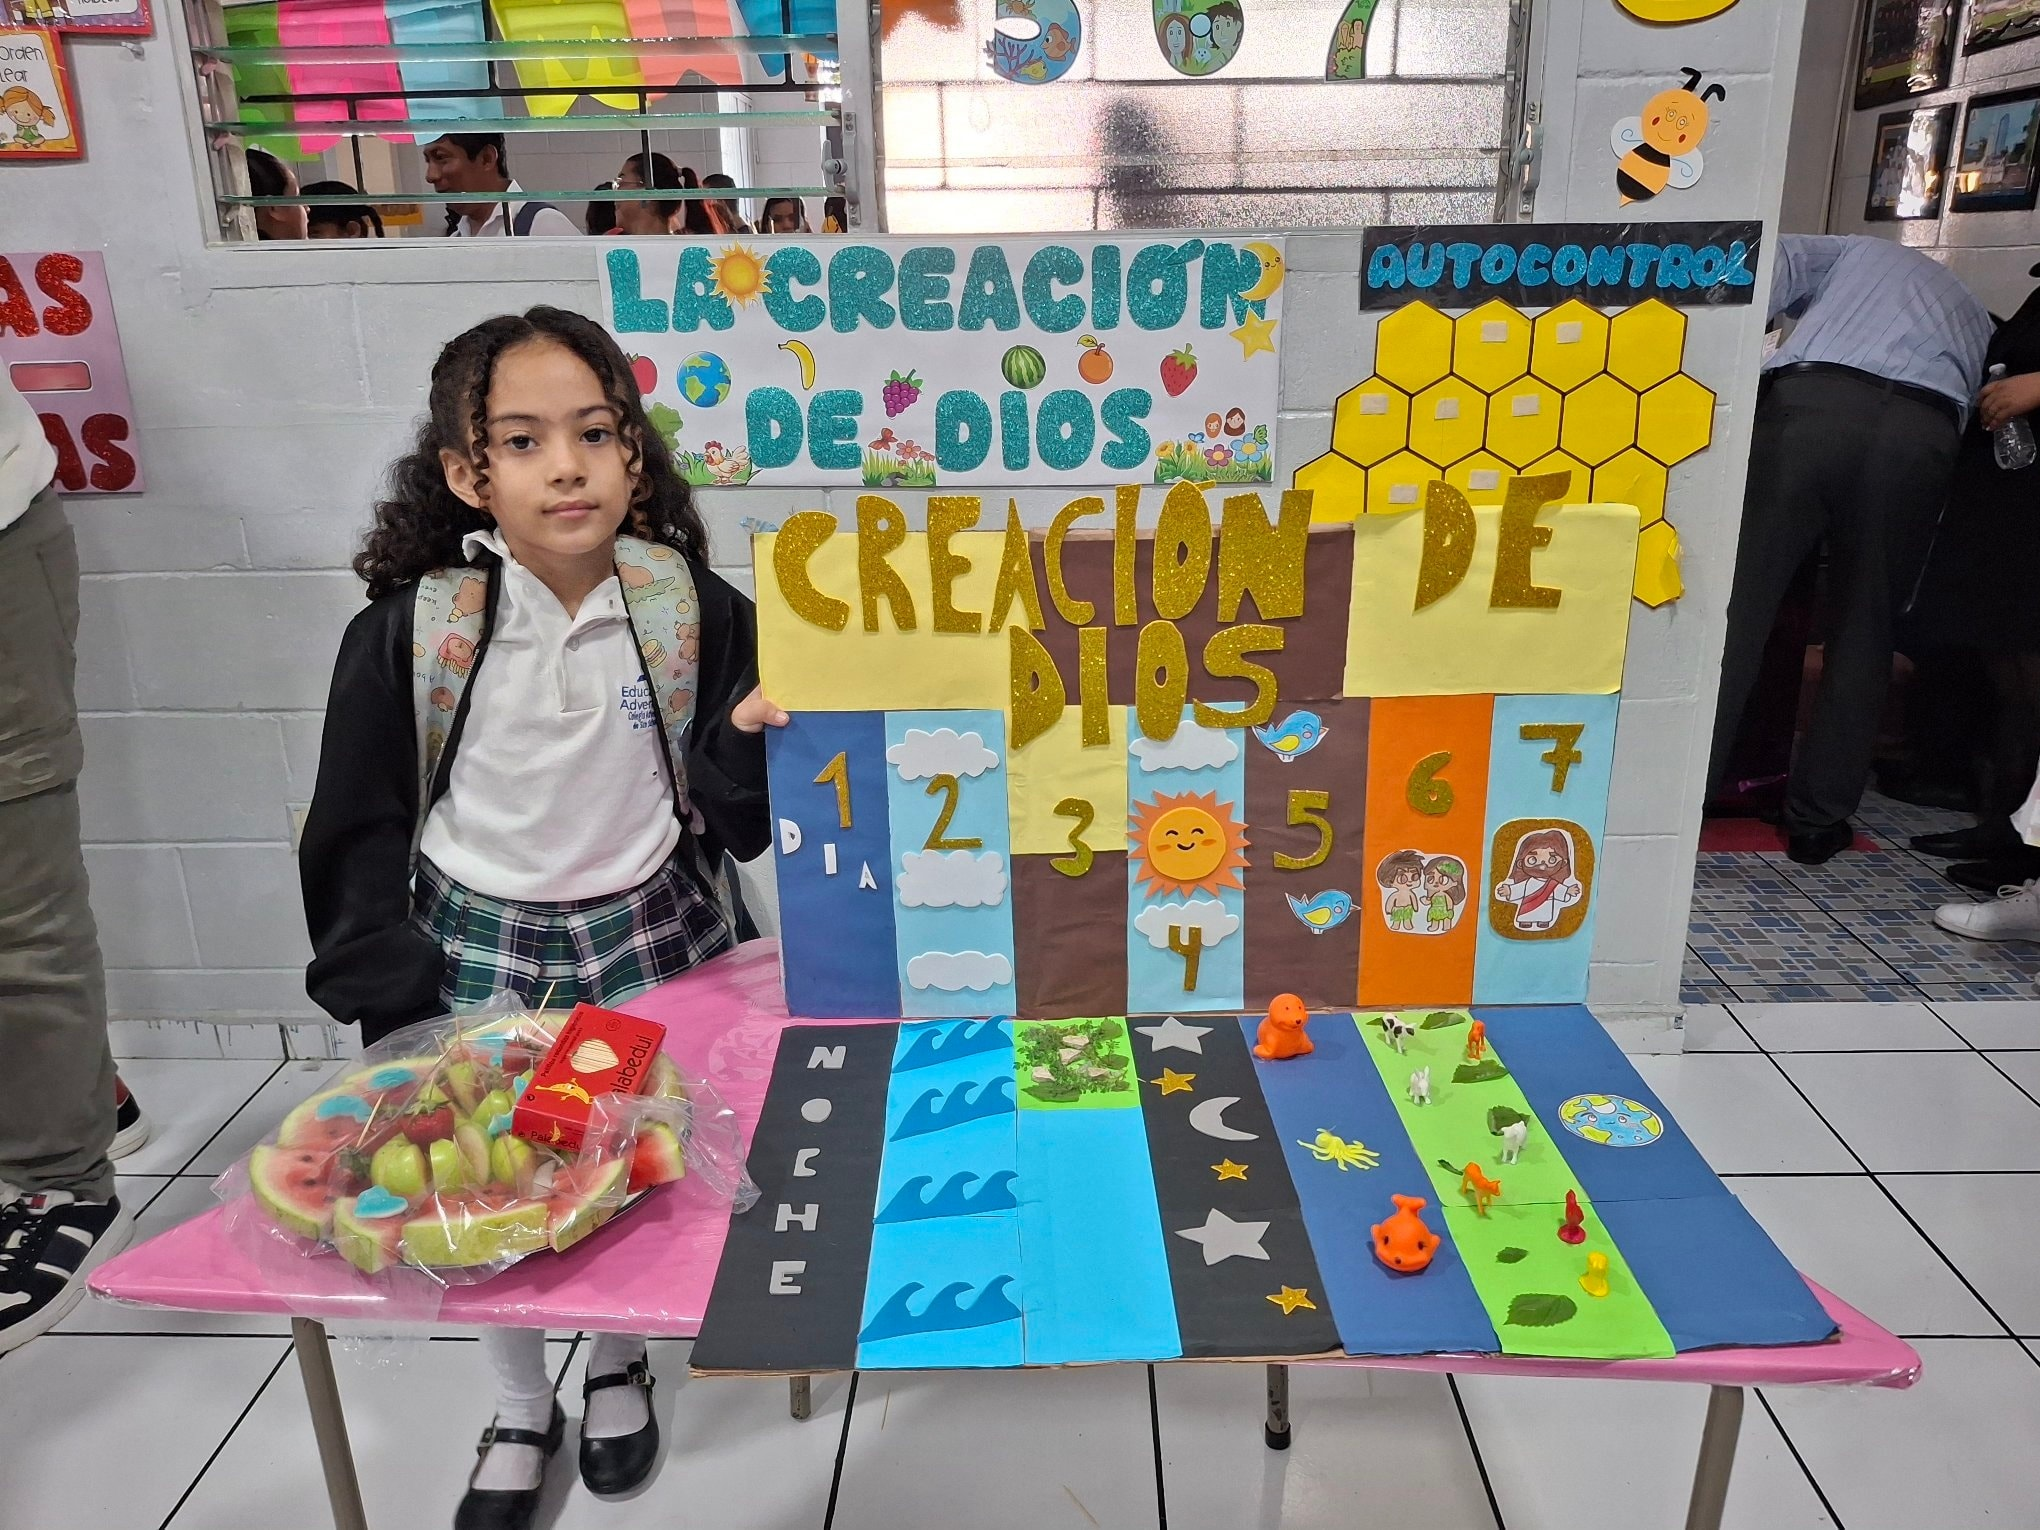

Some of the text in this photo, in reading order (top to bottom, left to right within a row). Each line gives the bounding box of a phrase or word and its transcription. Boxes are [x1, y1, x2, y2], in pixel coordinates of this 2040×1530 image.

[605, 245, 737, 334] LA
[1366, 240, 1754, 290] AUTOCONTROL
[744, 386, 1153, 473] DE DIOS
[1413, 469, 1573, 614] DE
[1009, 619, 1285, 750] DIOS
[813, 751, 853, 829] 1
[1406, 751, 1455, 815] 6
[1518, 722, 1586, 793] 7
[923, 773, 983, 850] 2
[1047, 797, 1095, 878] 3
[1272, 789, 1332, 870] 5
[1168, 923, 1202, 992] 4
